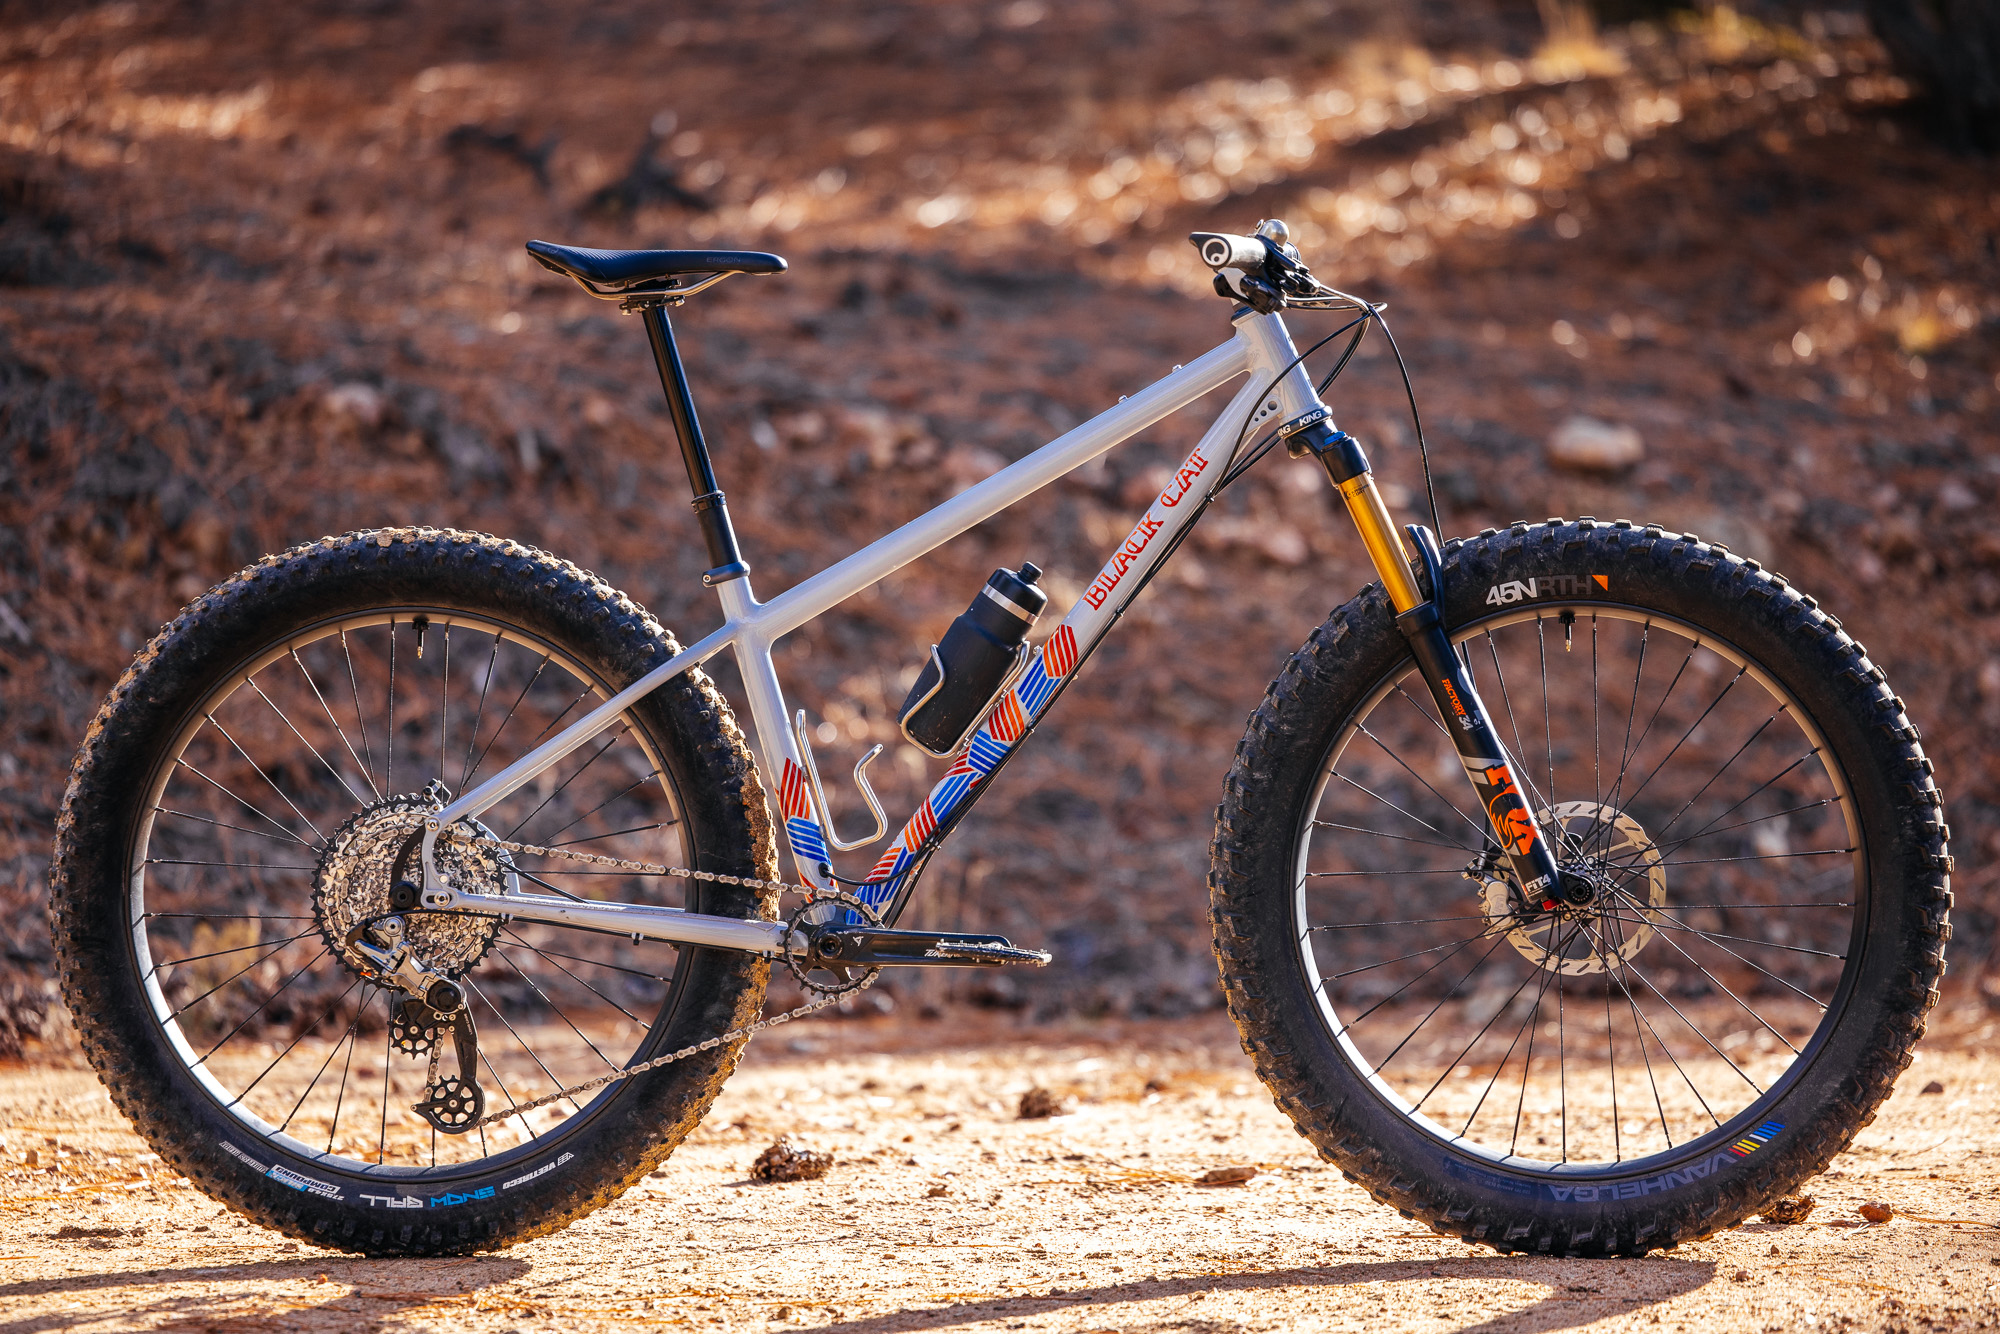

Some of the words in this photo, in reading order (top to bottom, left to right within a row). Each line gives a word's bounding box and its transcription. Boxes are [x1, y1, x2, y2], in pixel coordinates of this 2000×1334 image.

[1299, 410, 1322, 427] KING
[1082, 511, 1164, 611] BLACK
[1160, 447, 1209, 507] CAT
[1441, 678, 1467, 716] FACTORY
[1458, 714, 1474, 731] 34
[1486, 765, 1541, 856] FOX
[274, 1166, 337, 1193] COMPOUND
[359, 1193, 424, 1209] BALL
[1550, 1152, 1737, 1202] VANHELGA
